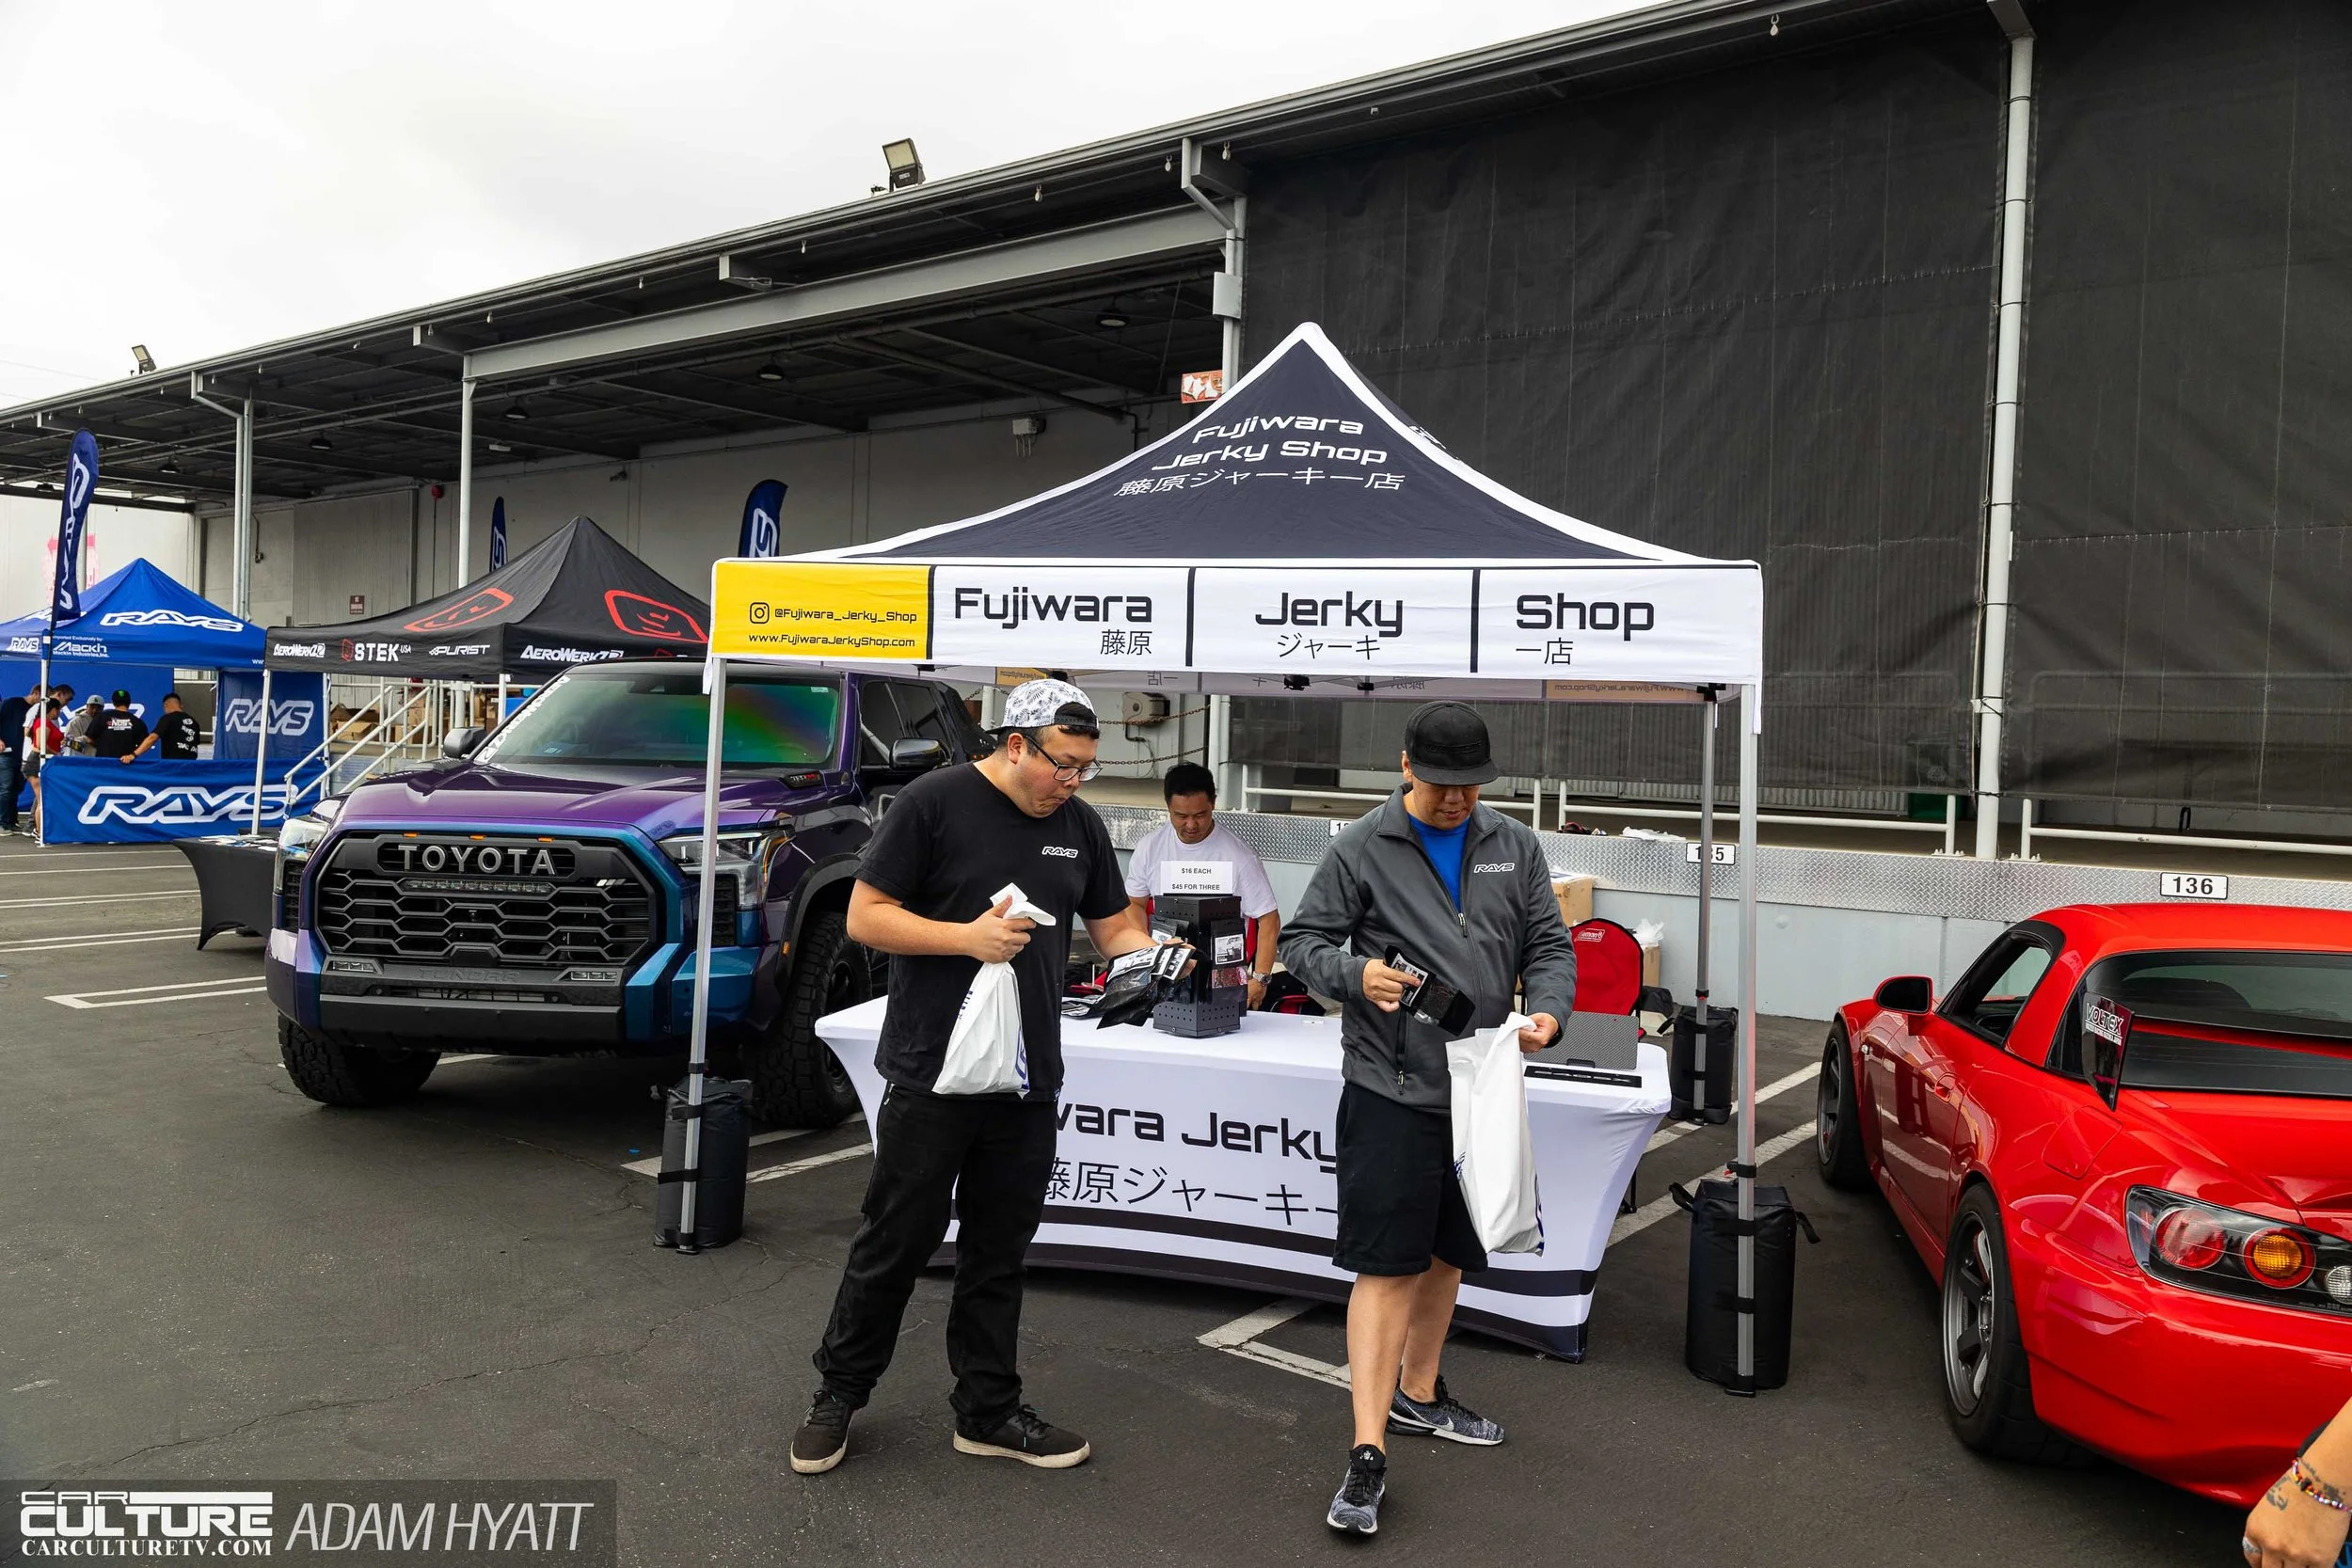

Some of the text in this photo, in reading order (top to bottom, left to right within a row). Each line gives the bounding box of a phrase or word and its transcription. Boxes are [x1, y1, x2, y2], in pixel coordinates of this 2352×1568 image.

[1192, 416, 1364, 444] Fujiwara
[1152, 440, 1388, 471] Jerky Shop
[1114, 467, 1406, 497] 藤原ジャーキー店
[100, 609, 244, 632] RAYS
[774, 607, 917, 625] @Fujiwara_Jerky_Shop
[954, 586, 1655, 641] Fujiwara Jerky Shop
[7, 637, 40, 653] RAYS
[354, 642, 412, 662] STEK USA
[748, 632, 915, 648] www.FujiwaraJerkyShop.com
[1100, 629, 1153, 657] 藤原
[225, 698, 314, 736] RAYS
[78, 784, 299, 825] RAYS
[397, 844, 557, 876] TOYOTA
[1041, 846, 1078, 858] RAYS
[1695, 846, 1724, 862] 15
[1473, 862, 1515, 873] RAYS
[2172, 876, 2213, 895] 136
[2086, 1003, 2124, 1036] VOLTEX
[1181, 1112, 1337, 1175] Jerky
